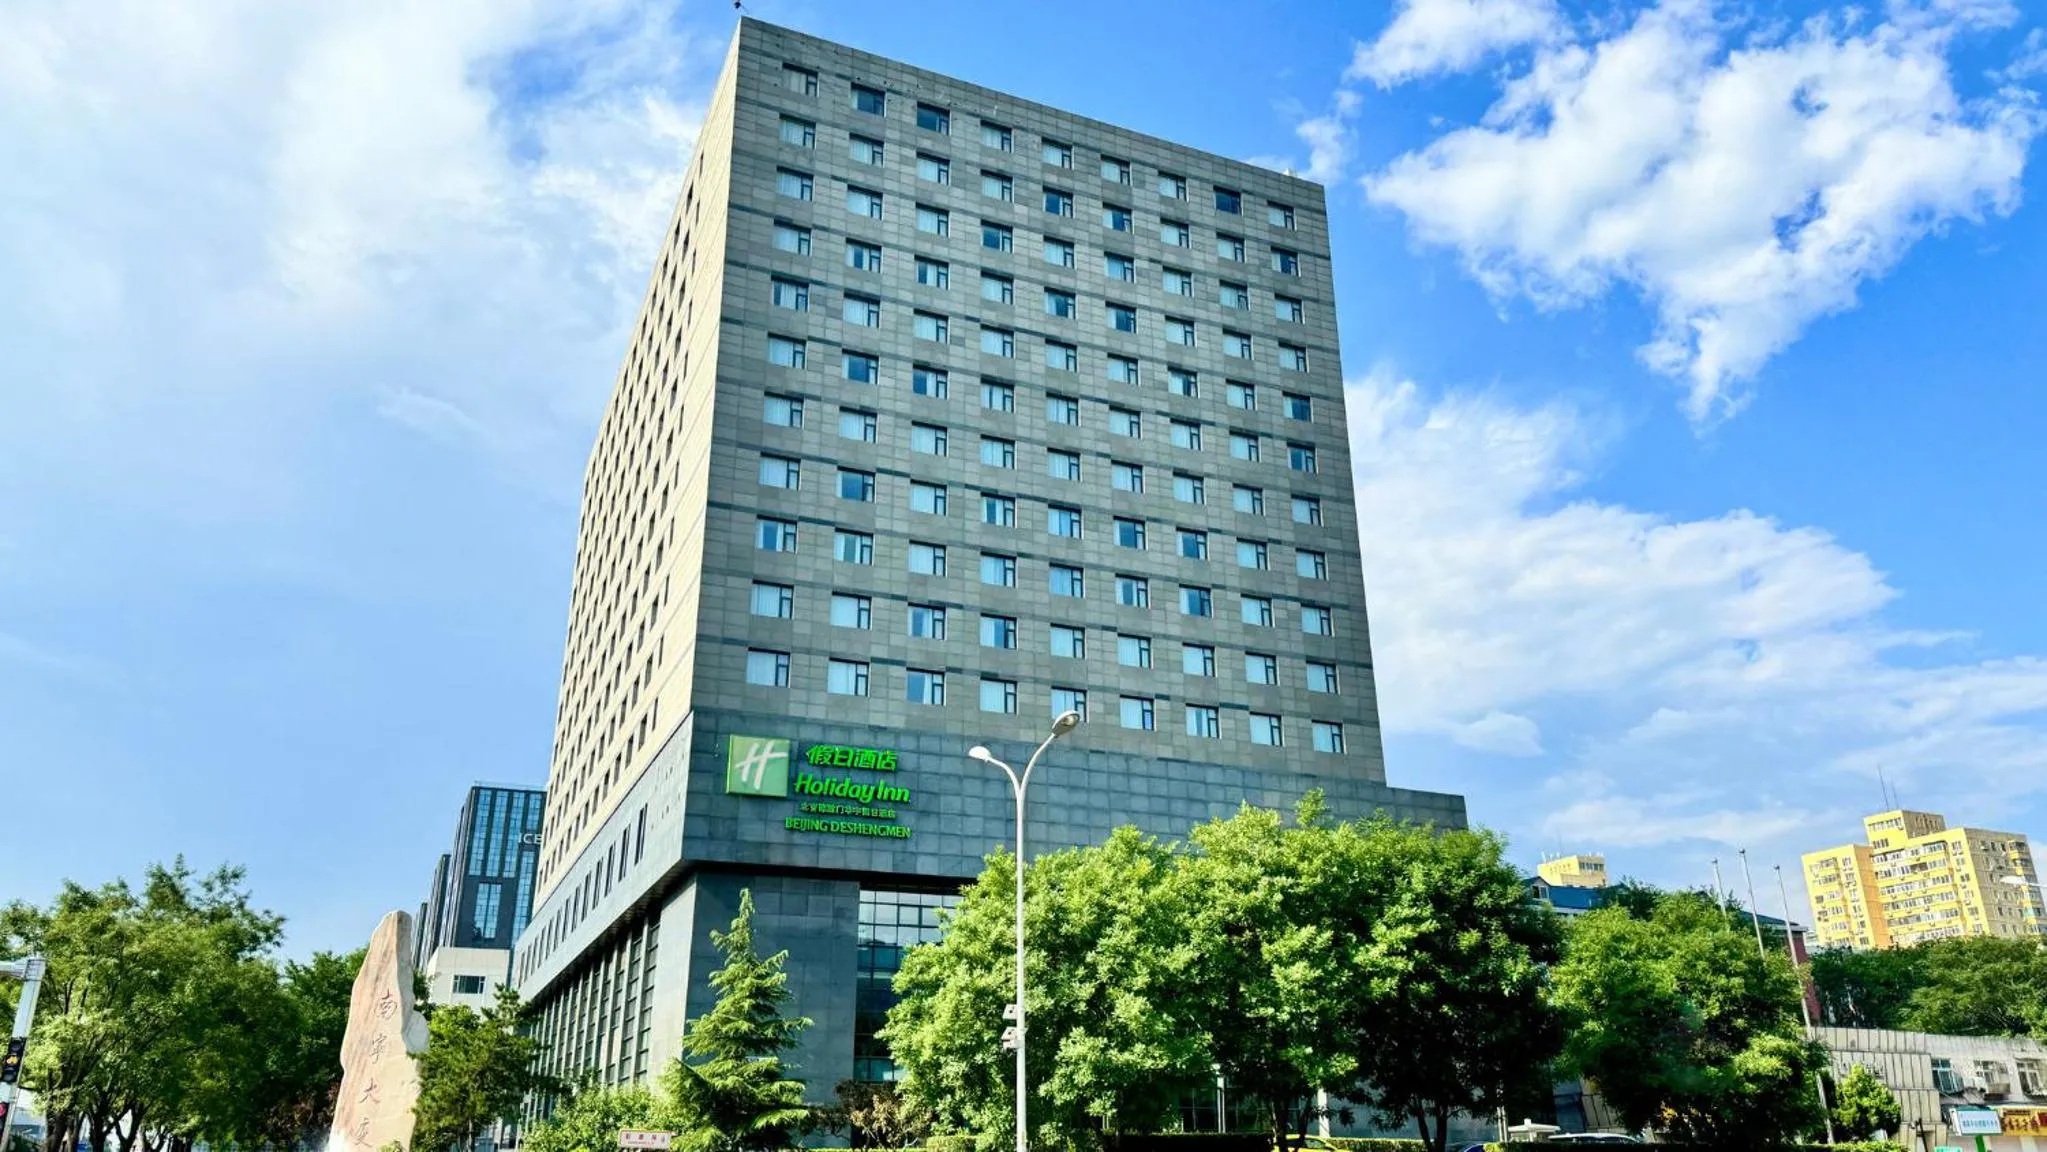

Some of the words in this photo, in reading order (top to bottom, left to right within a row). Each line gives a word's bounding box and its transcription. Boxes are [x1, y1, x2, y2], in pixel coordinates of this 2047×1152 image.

[806, 744, 897, 771] 假日酒店
[795, 772, 875, 803] Holiday
[877, 779, 910, 802] Inn
[785, 817, 828, 832] BEIJING
[830, 821, 911, 838] DESHENGMEN
